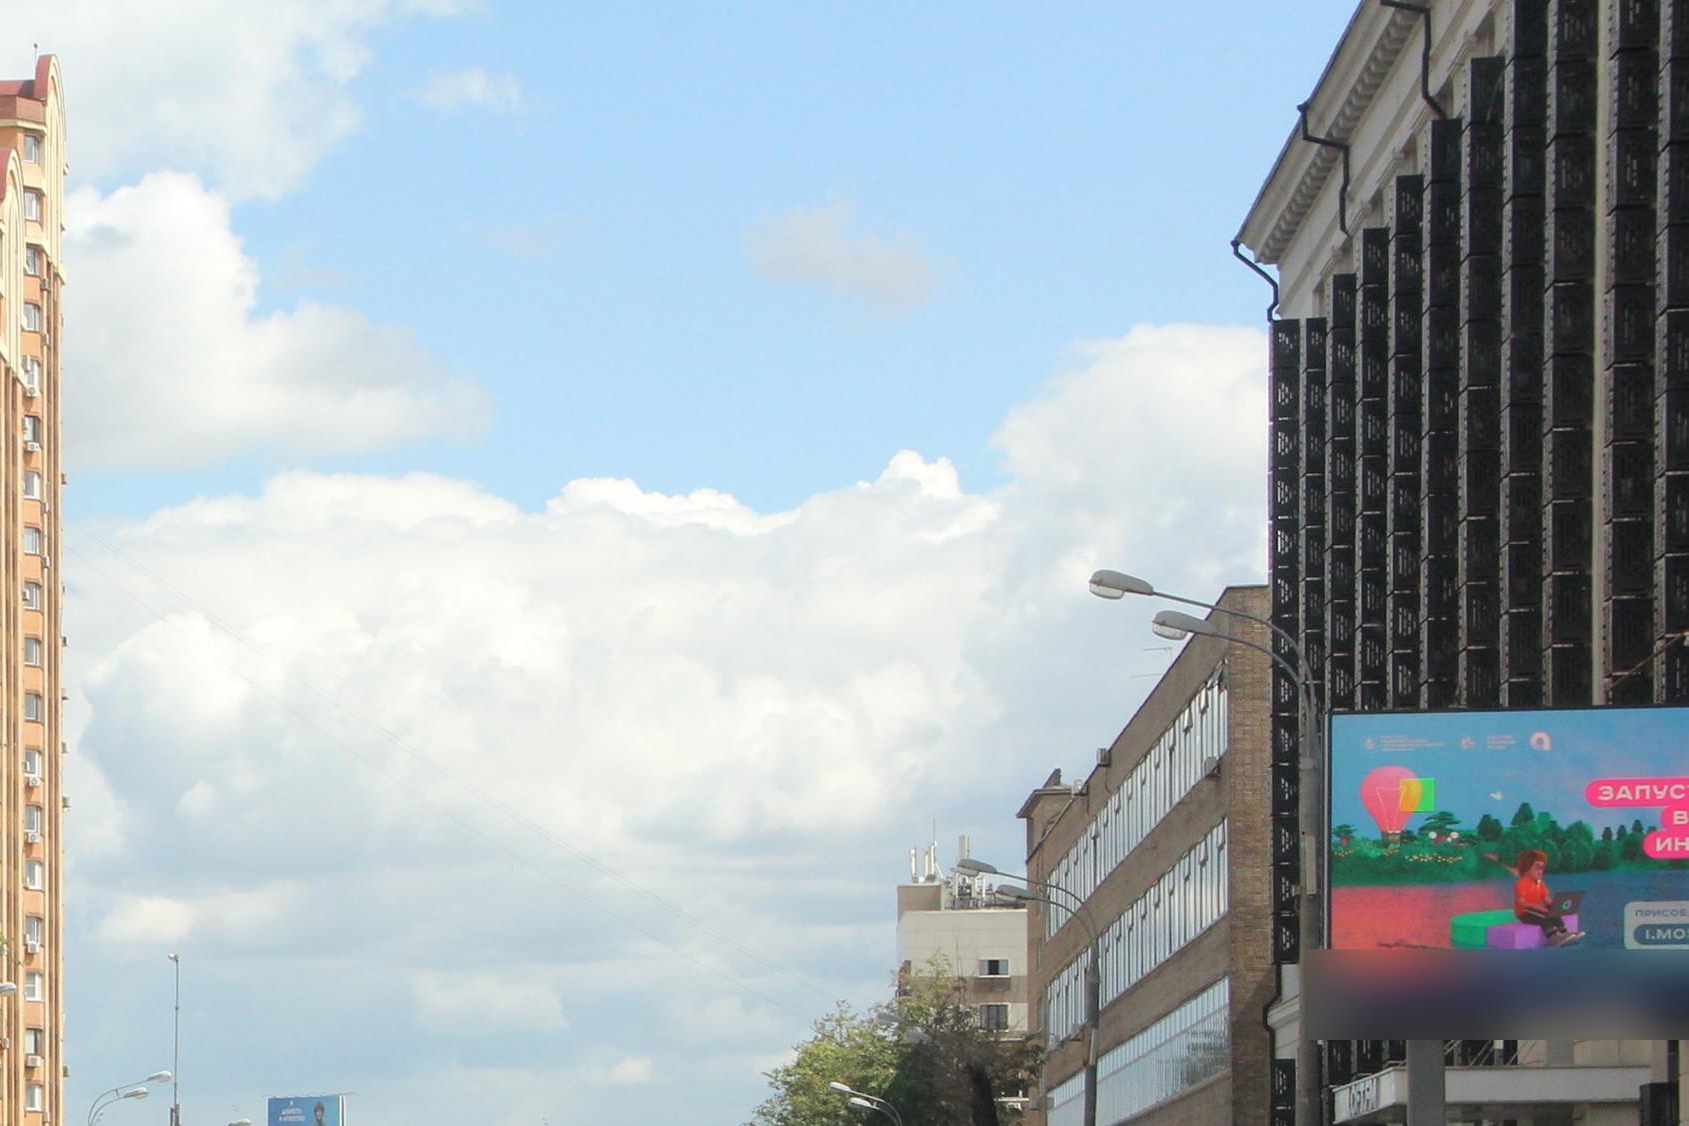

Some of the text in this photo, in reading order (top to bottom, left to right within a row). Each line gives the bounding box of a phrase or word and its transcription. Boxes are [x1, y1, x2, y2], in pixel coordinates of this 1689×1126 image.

[1598, 784, 1689, 801] ЗАПУС
[1635, 907, 1689, 918] ПРИСОЕ
[1645, 927, 1689, 941] I.MO
